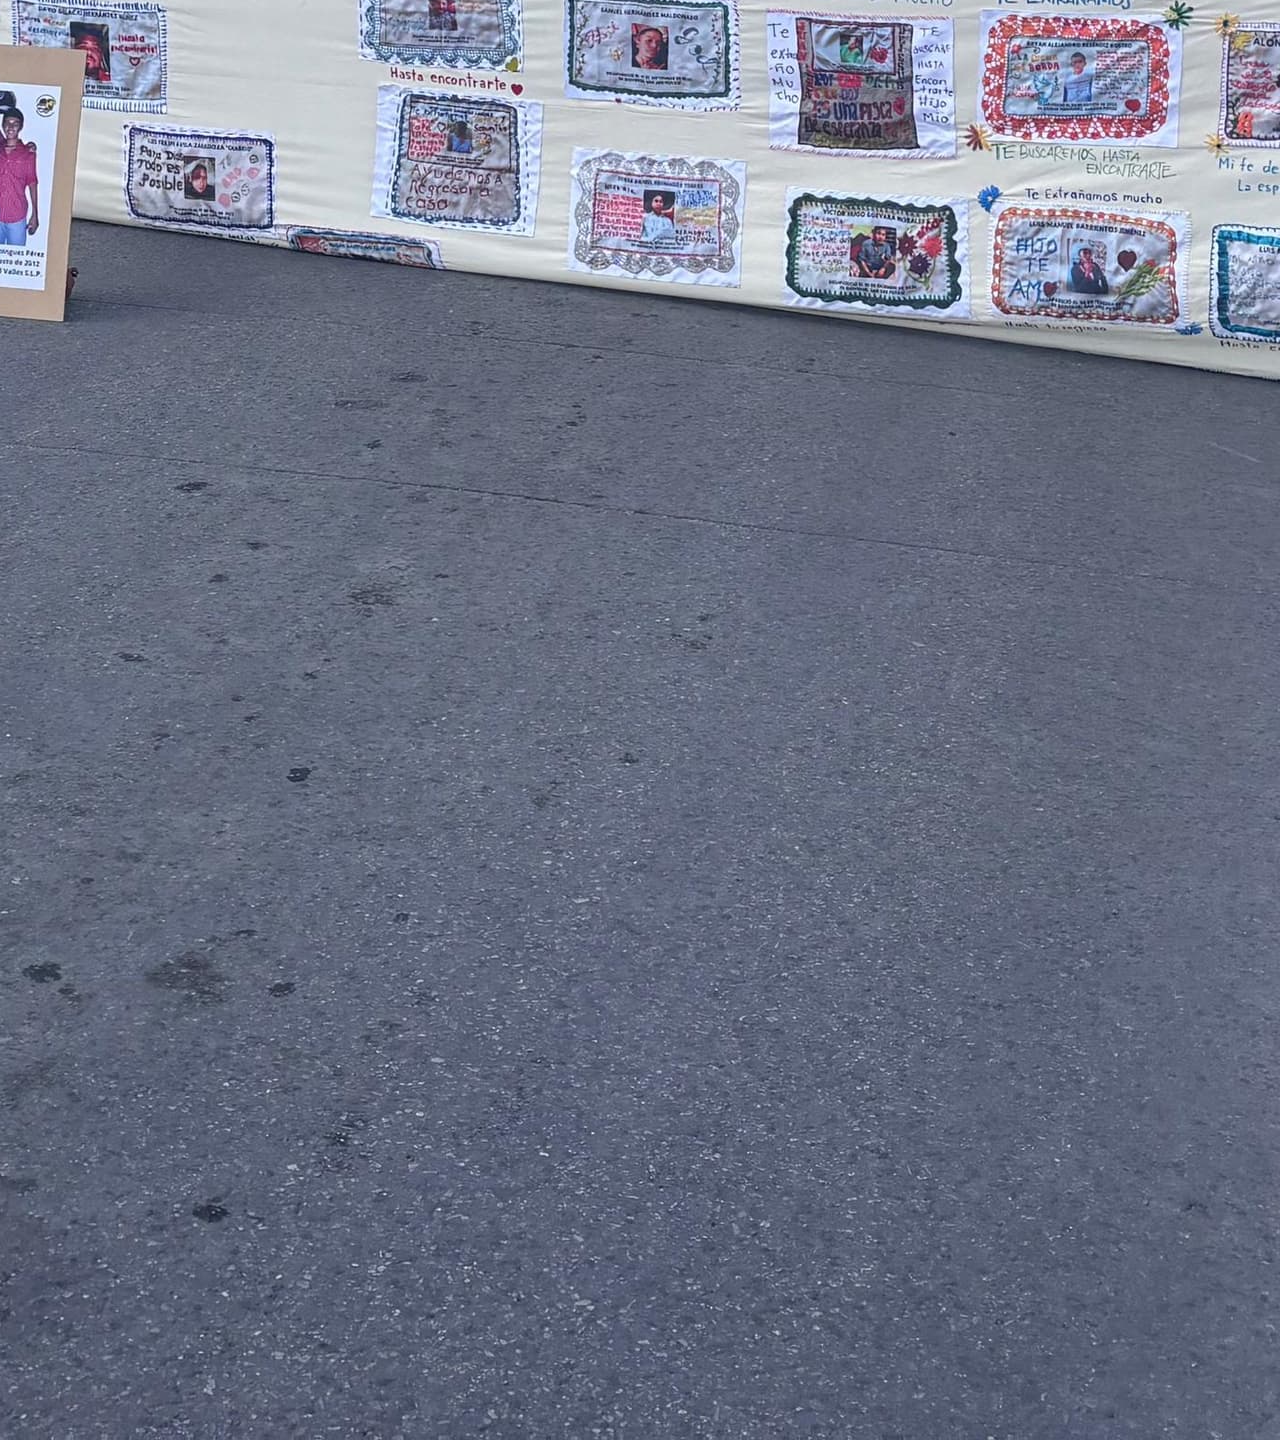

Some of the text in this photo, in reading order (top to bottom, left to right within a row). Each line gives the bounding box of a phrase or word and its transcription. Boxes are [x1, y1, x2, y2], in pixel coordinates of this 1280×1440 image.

[768, 24, 789, 38] Te
[920, 28, 940, 36] TE
[390, 67, 506, 90] Hasta encontrarte
[993, 144, 1140, 162] TE BUSCAREMOS HASTA
[1086, 163, 1177, 179] ENCONTRARTE
[1219, 158, 1234, 170] Mi
[1239, 158, 1253, 173] fe
[1263, 161, 1279, 174] de
[1238, 180, 1251, 192] La
[1025, 188, 1162, 204] Te Extrañamos mucho
[1259, 247, 1275, 255] LUIS
[1027, 258, 1050, 272] TE
